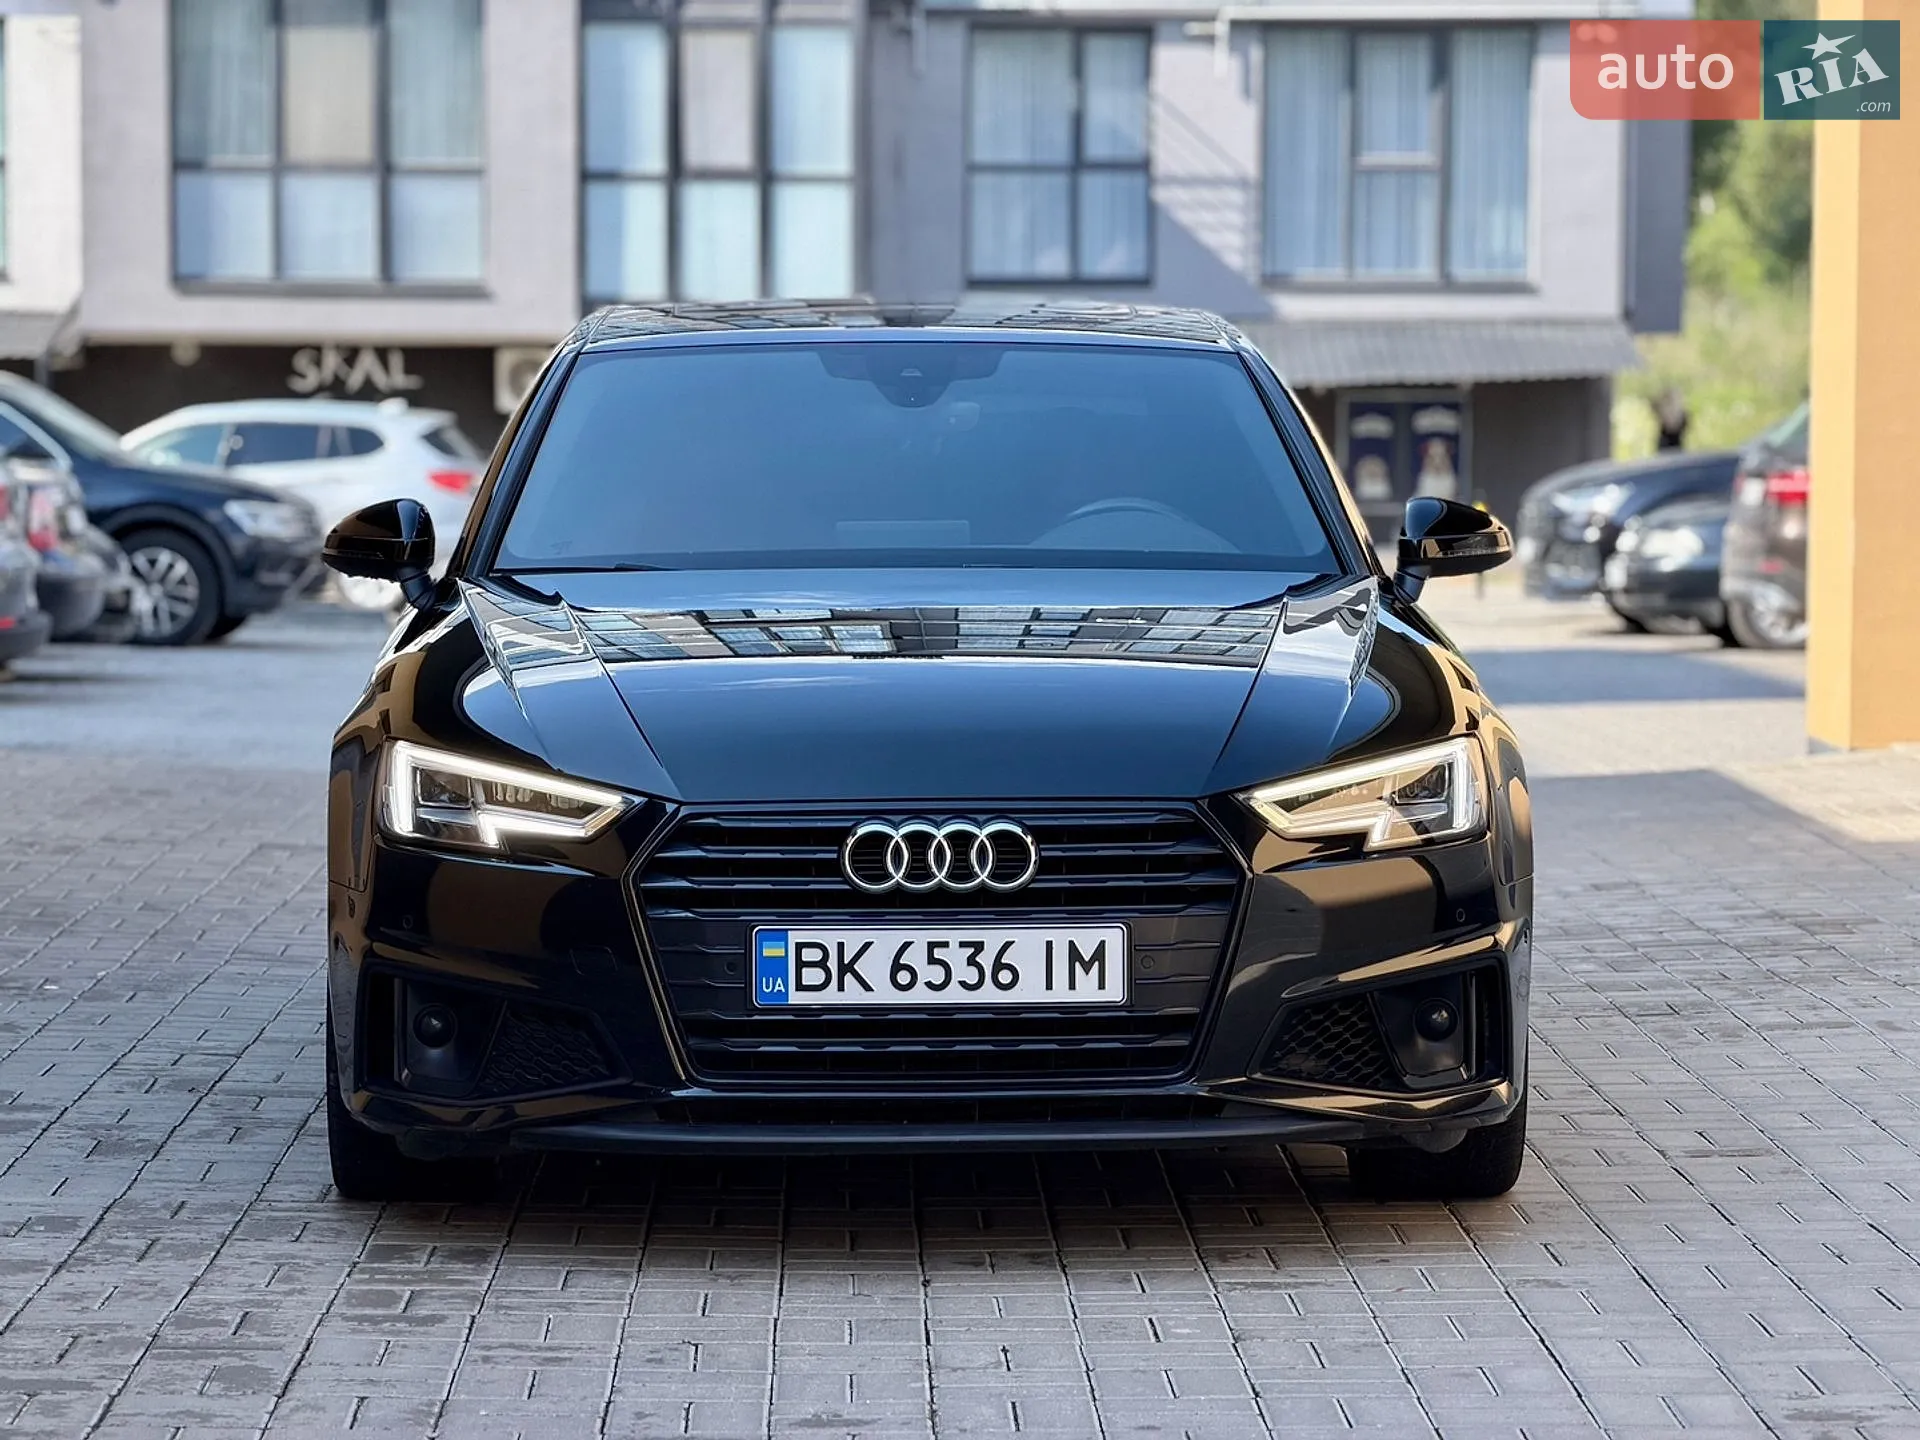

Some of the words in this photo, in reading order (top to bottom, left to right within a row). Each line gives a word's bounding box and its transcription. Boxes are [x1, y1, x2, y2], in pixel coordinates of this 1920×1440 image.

[794, 940, 875, 992] BK
[889, 940, 1020, 992] 6536
[1045, 939, 1106, 991] IM
[762, 977, 785, 993] UA
